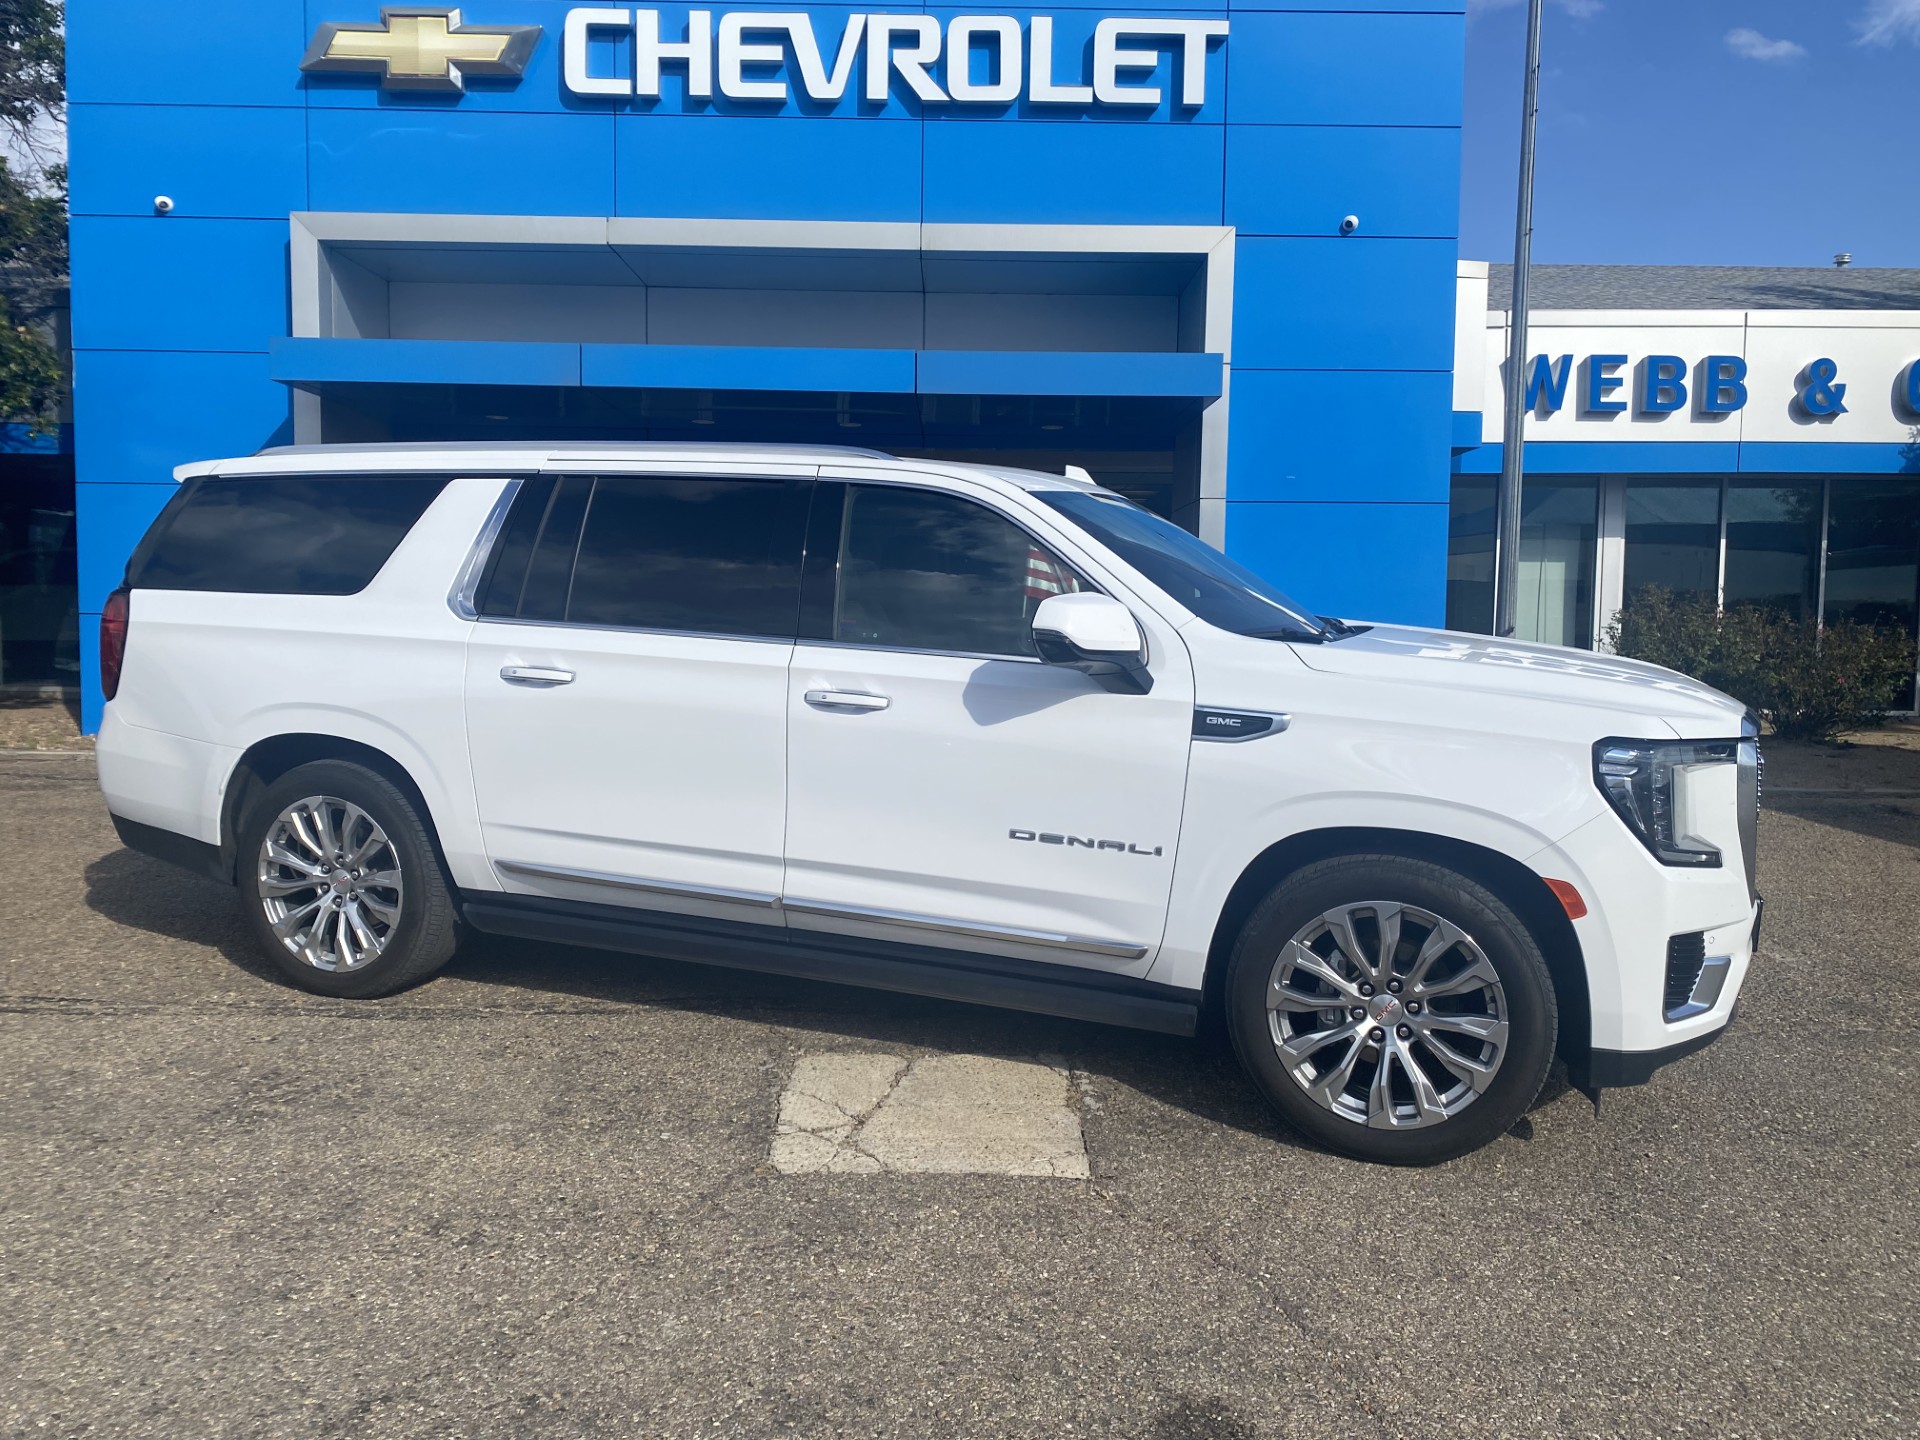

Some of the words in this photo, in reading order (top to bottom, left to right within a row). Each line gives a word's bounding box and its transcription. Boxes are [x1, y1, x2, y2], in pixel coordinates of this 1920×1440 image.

[564, 7, 1230, 105] CHEVROLET
[1522, 353, 1748, 413] WEBB
[1803, 357, 1850, 415] &
[1206, 716, 1242, 727] GMC
[1008, 828, 1163, 857] DENALI
[1375, 999, 1397, 1022] GMC
